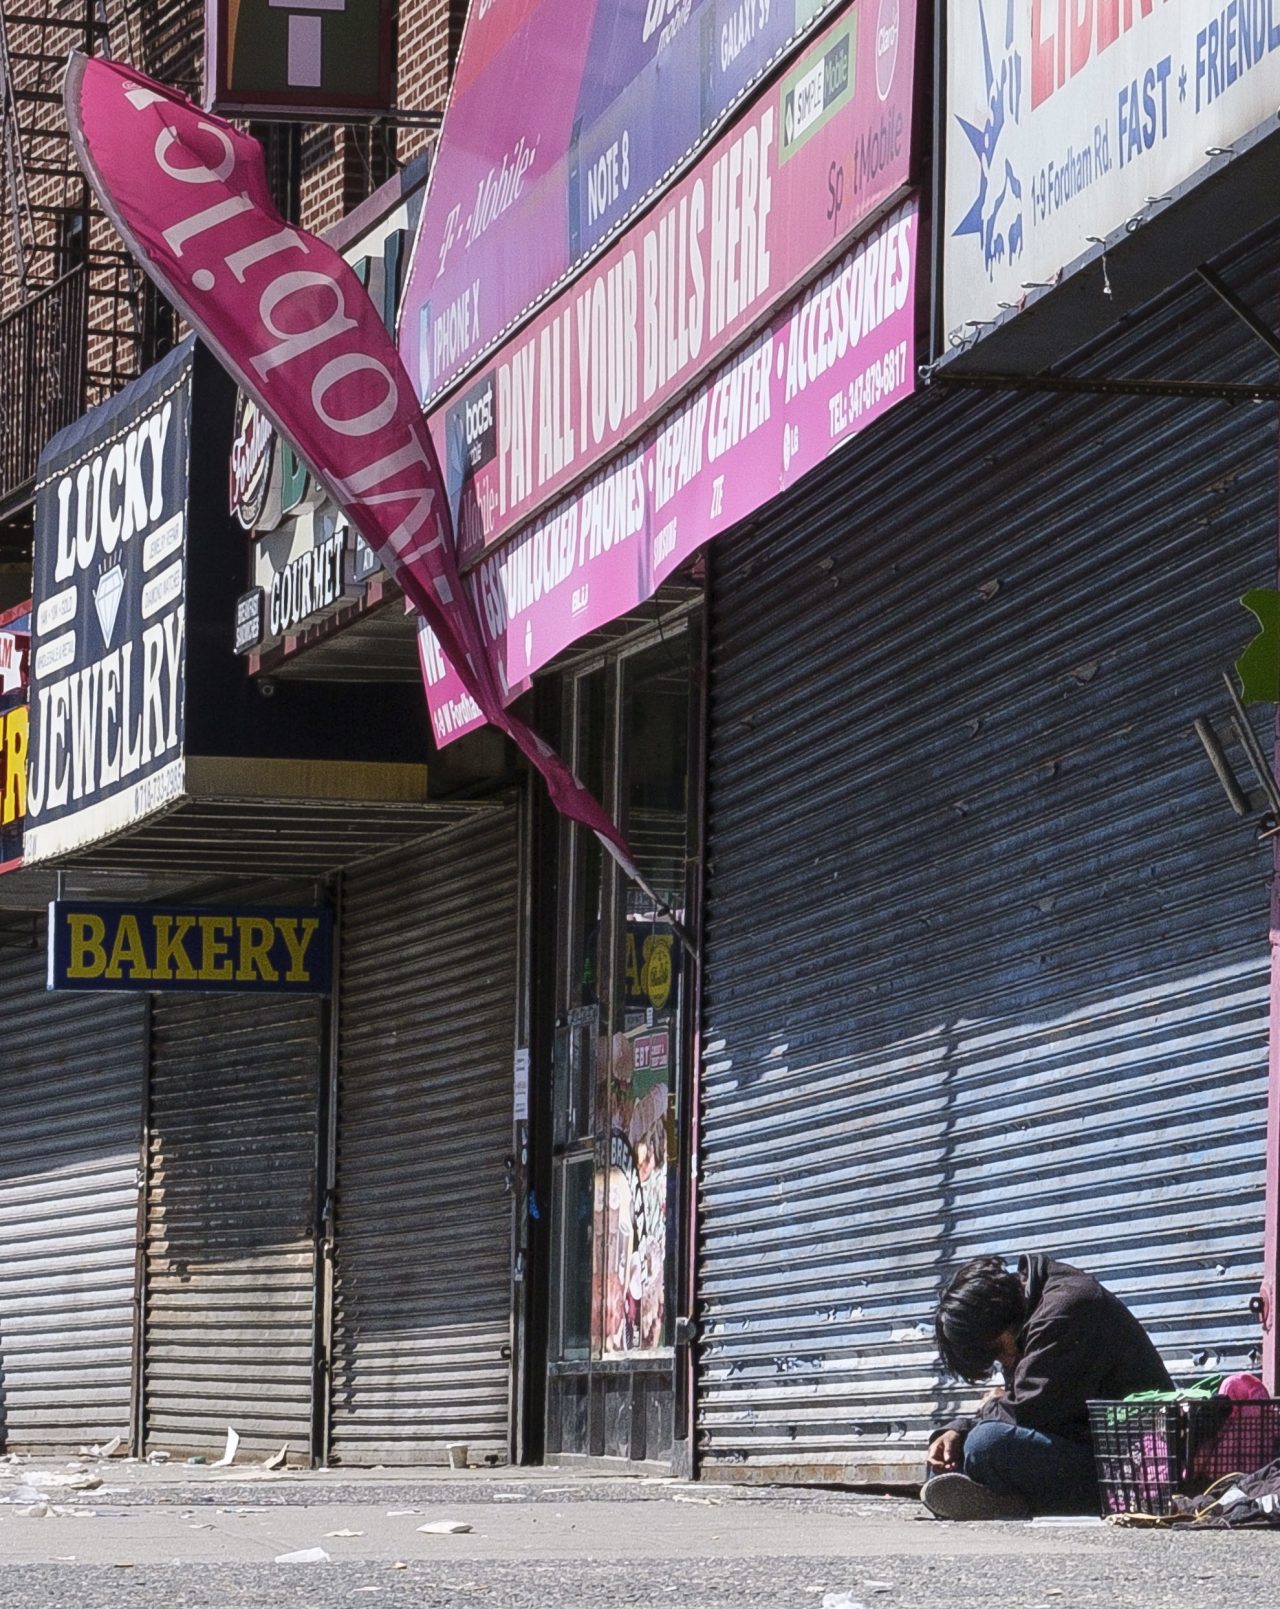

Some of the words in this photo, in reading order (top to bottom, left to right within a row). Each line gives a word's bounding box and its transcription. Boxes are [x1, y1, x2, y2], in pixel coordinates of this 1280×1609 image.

[720, 0, 756, 72] GALAXY
[797, 71, 823, 125] SIMPLE
[1117, 54, 1173, 170] FAST
[586, 140, 619, 227] NOTE
[621, 129, 630, 191] 8
[1030, 174, 1046, 227] 1-9
[1047, 146, 1092, 216] Fordham
[1094, 118, 1113, 185] Rd.
[433, 288, 470, 381] IPHONE
[472, 278, 480, 344] X
[498, 337, 536, 516] PAY
[538, 306, 574, 487] ALL
[577, 248, 638, 454] YOUR
[643, 177, 705, 403] BILLS
[709, 105, 774, 341] HERE
[465, 381, 493, 445] boost
[506, 494, 578, 620] UNLOCKED
[578, 441, 645, 567] PHONES
[655, 384, 708, 513] REPAIR
[707, 327, 773, 463] CENTER
[785, 201, 912, 405] ACCESSORIES
[828, 390, 848, 438] TEL:
[54, 401, 173, 584] LUCKY
[270, 530, 345, 636] GOURMET
[571, 583, 589, 615] BLU
[27, 602, 185, 818] JEWELRY
[0, 706, 29, 826] R
[66, 912, 320, 982] BAKERY
[634, 1045, 650, 1068] EBT
